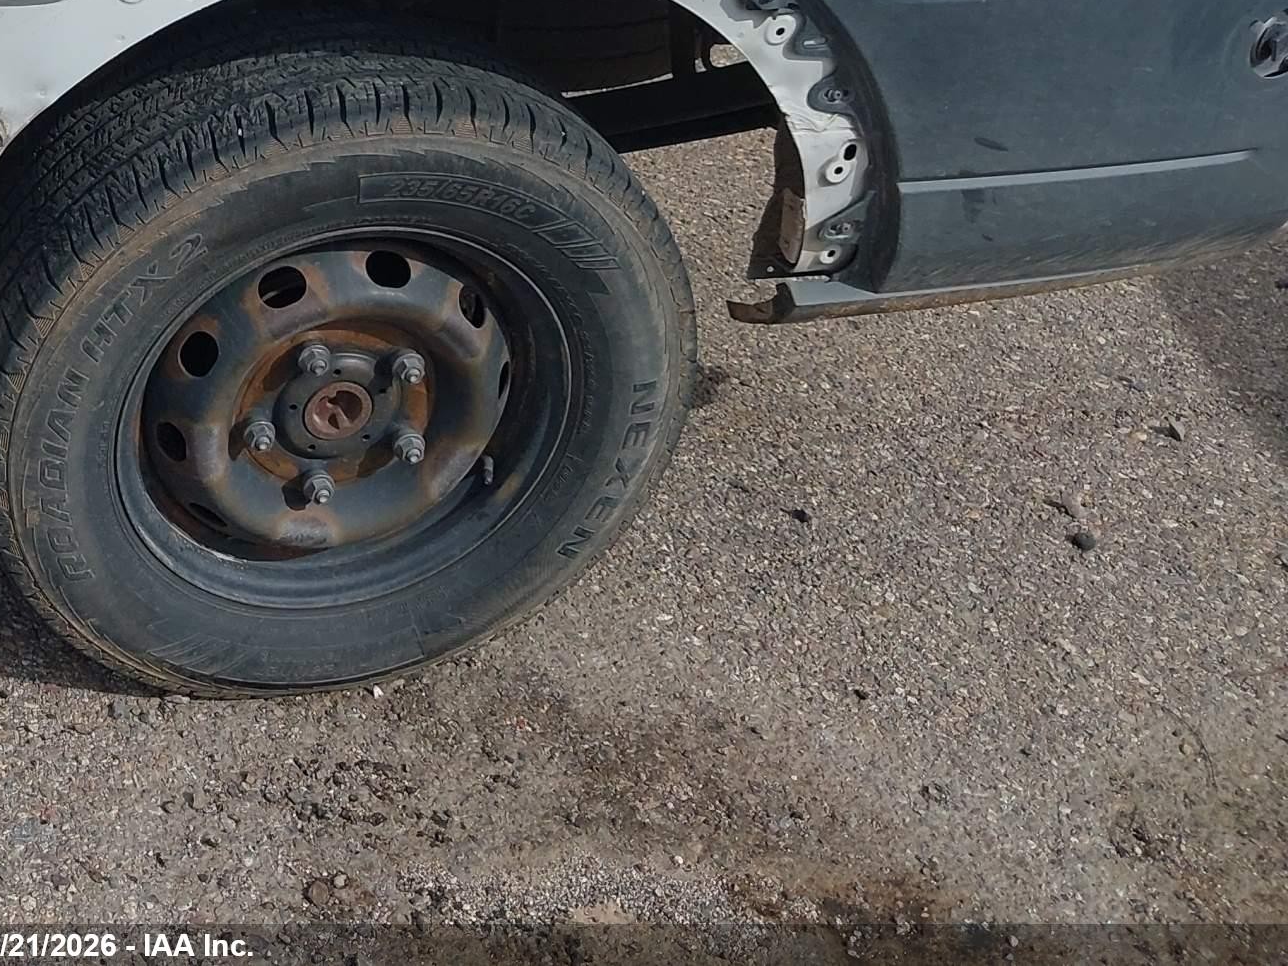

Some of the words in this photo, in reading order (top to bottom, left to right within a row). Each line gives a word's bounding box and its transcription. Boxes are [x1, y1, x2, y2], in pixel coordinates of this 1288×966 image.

[383, 177, 537, 220] 235/65R16C
[38, 367, 96, 582] ROADIAN
[555, 380, 658, 559] NEXEN
